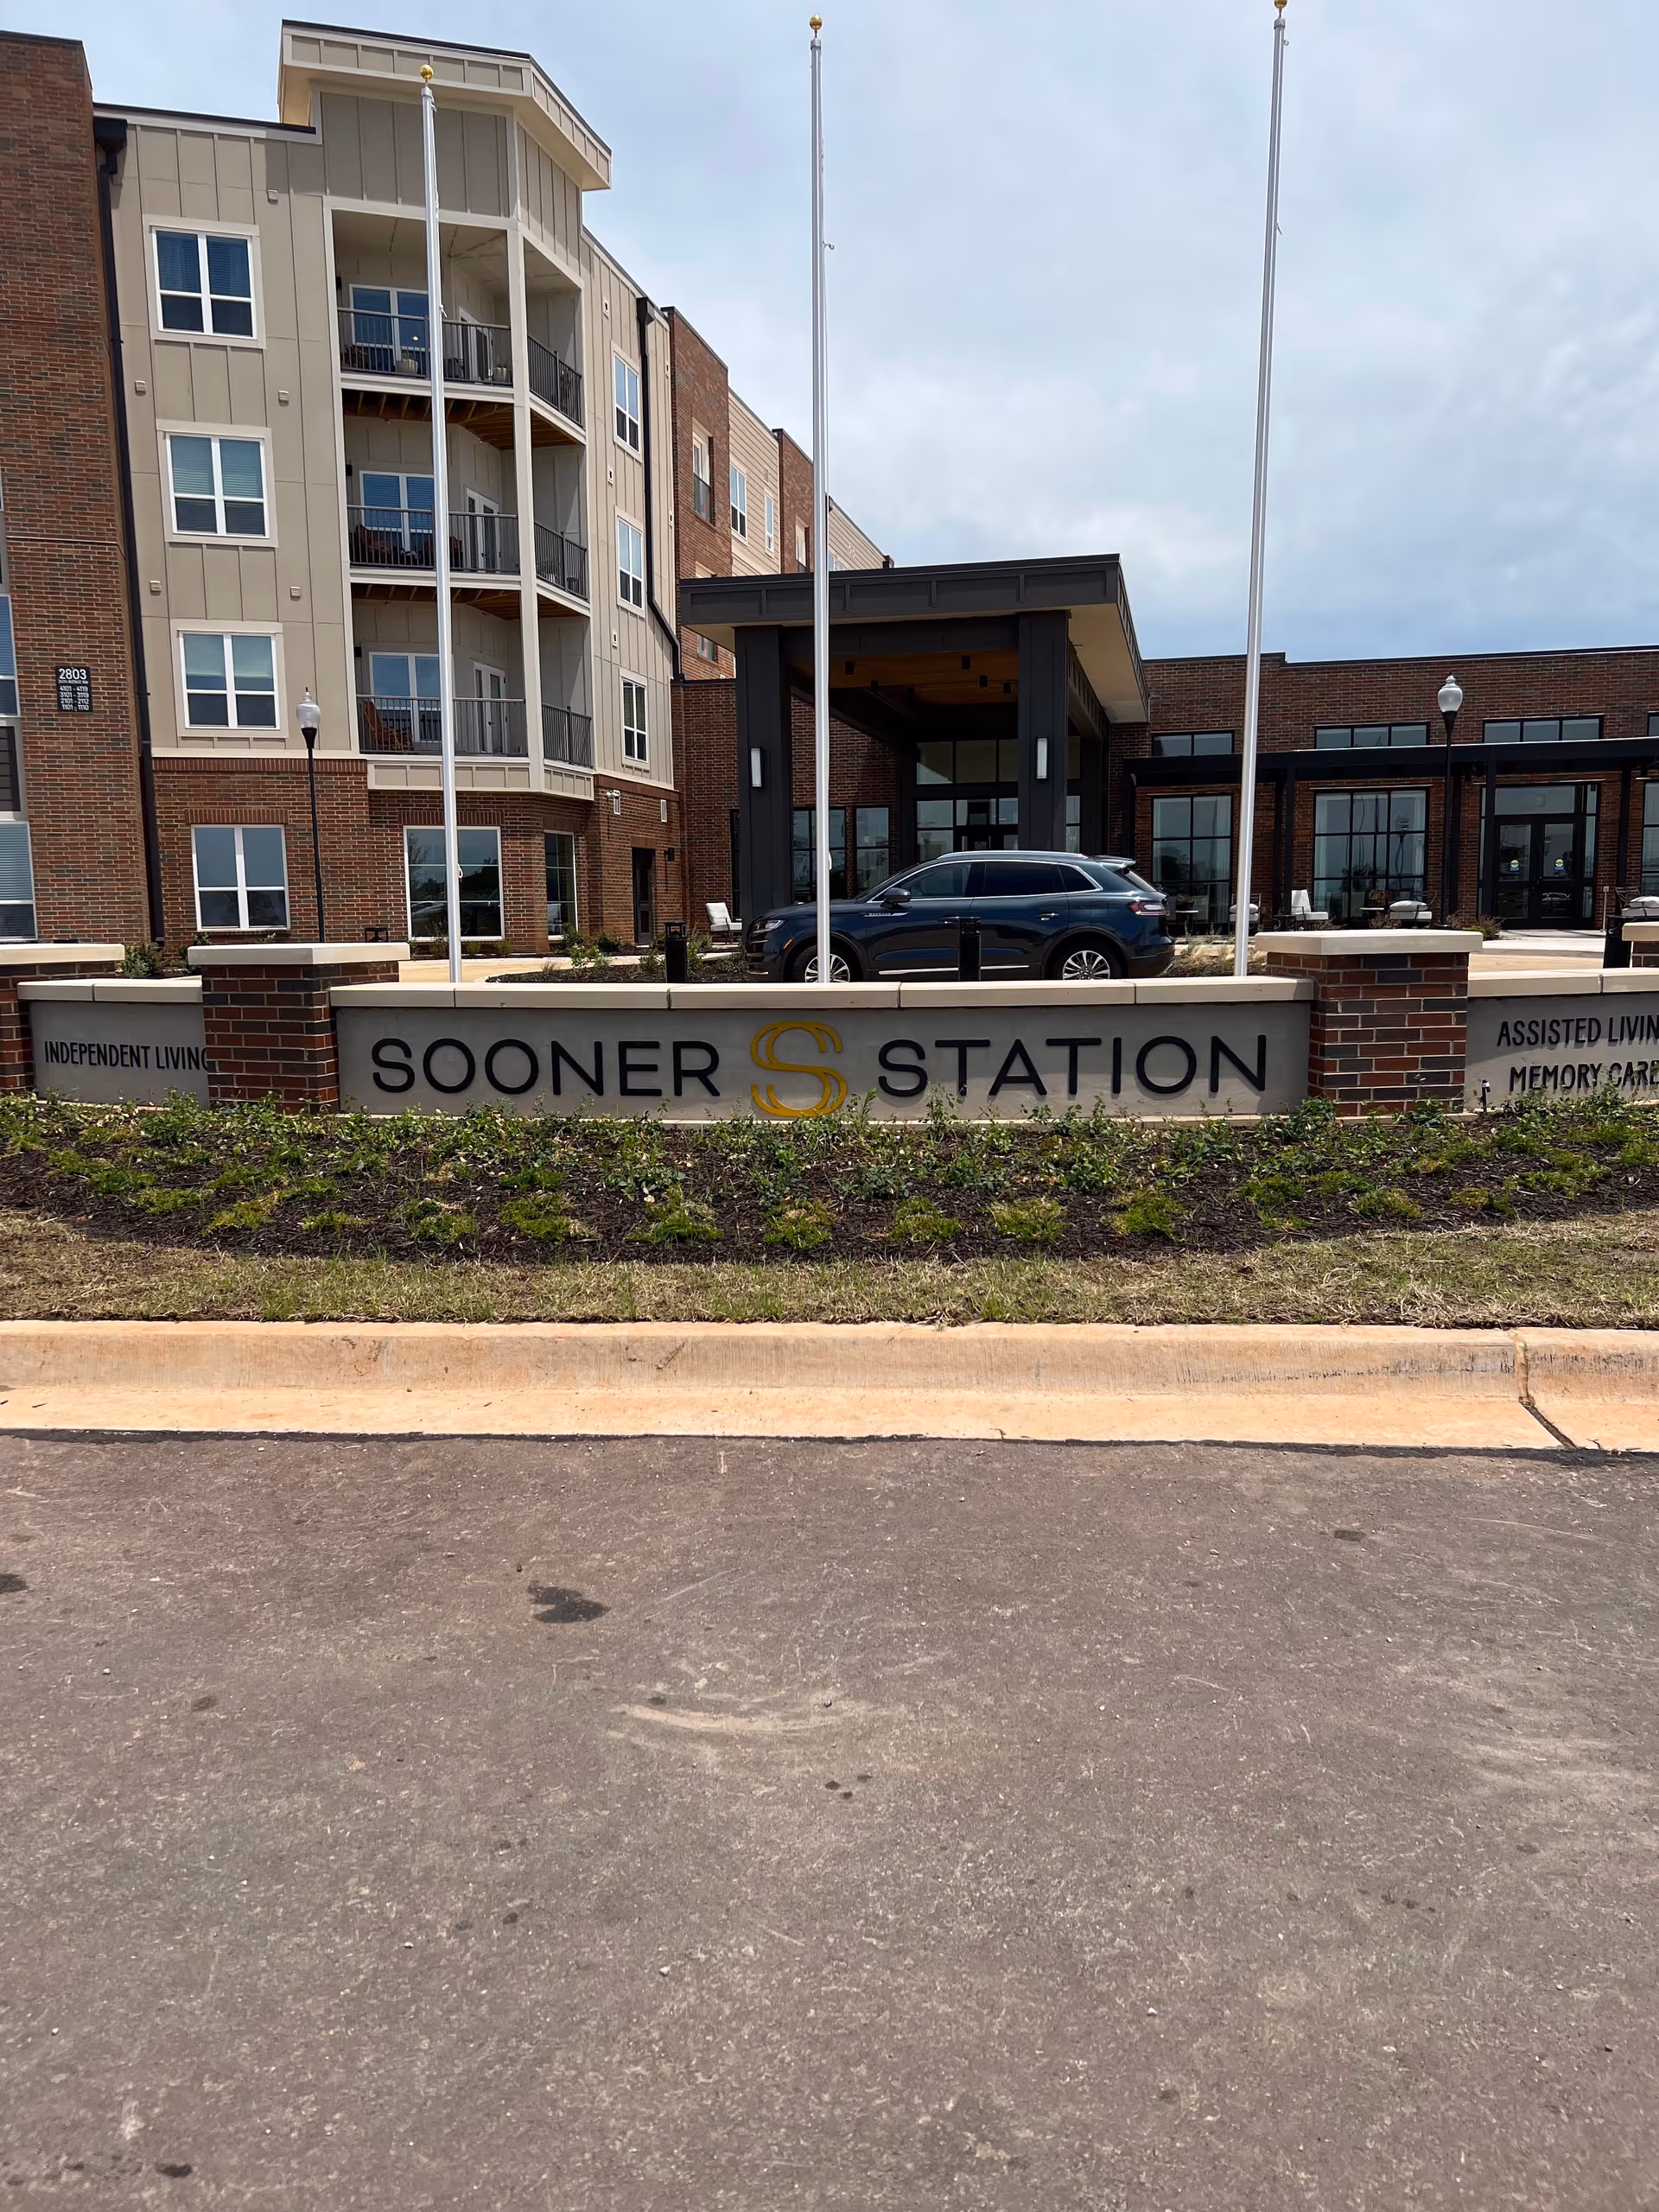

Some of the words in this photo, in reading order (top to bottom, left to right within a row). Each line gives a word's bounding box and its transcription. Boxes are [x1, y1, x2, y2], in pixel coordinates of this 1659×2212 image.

[59, 669, 87, 679] 2803
[1497, 1017, 1602, 1046] ASSISTED
[44, 1040, 150, 1069] INDEPENDENT
[371, 1037, 721, 1096] SOONER
[878, 1034, 1267, 1097] STATION
[1509, 1062, 1603, 1092] MEMORY
[1608, 1059, 1659, 1088] CARE
